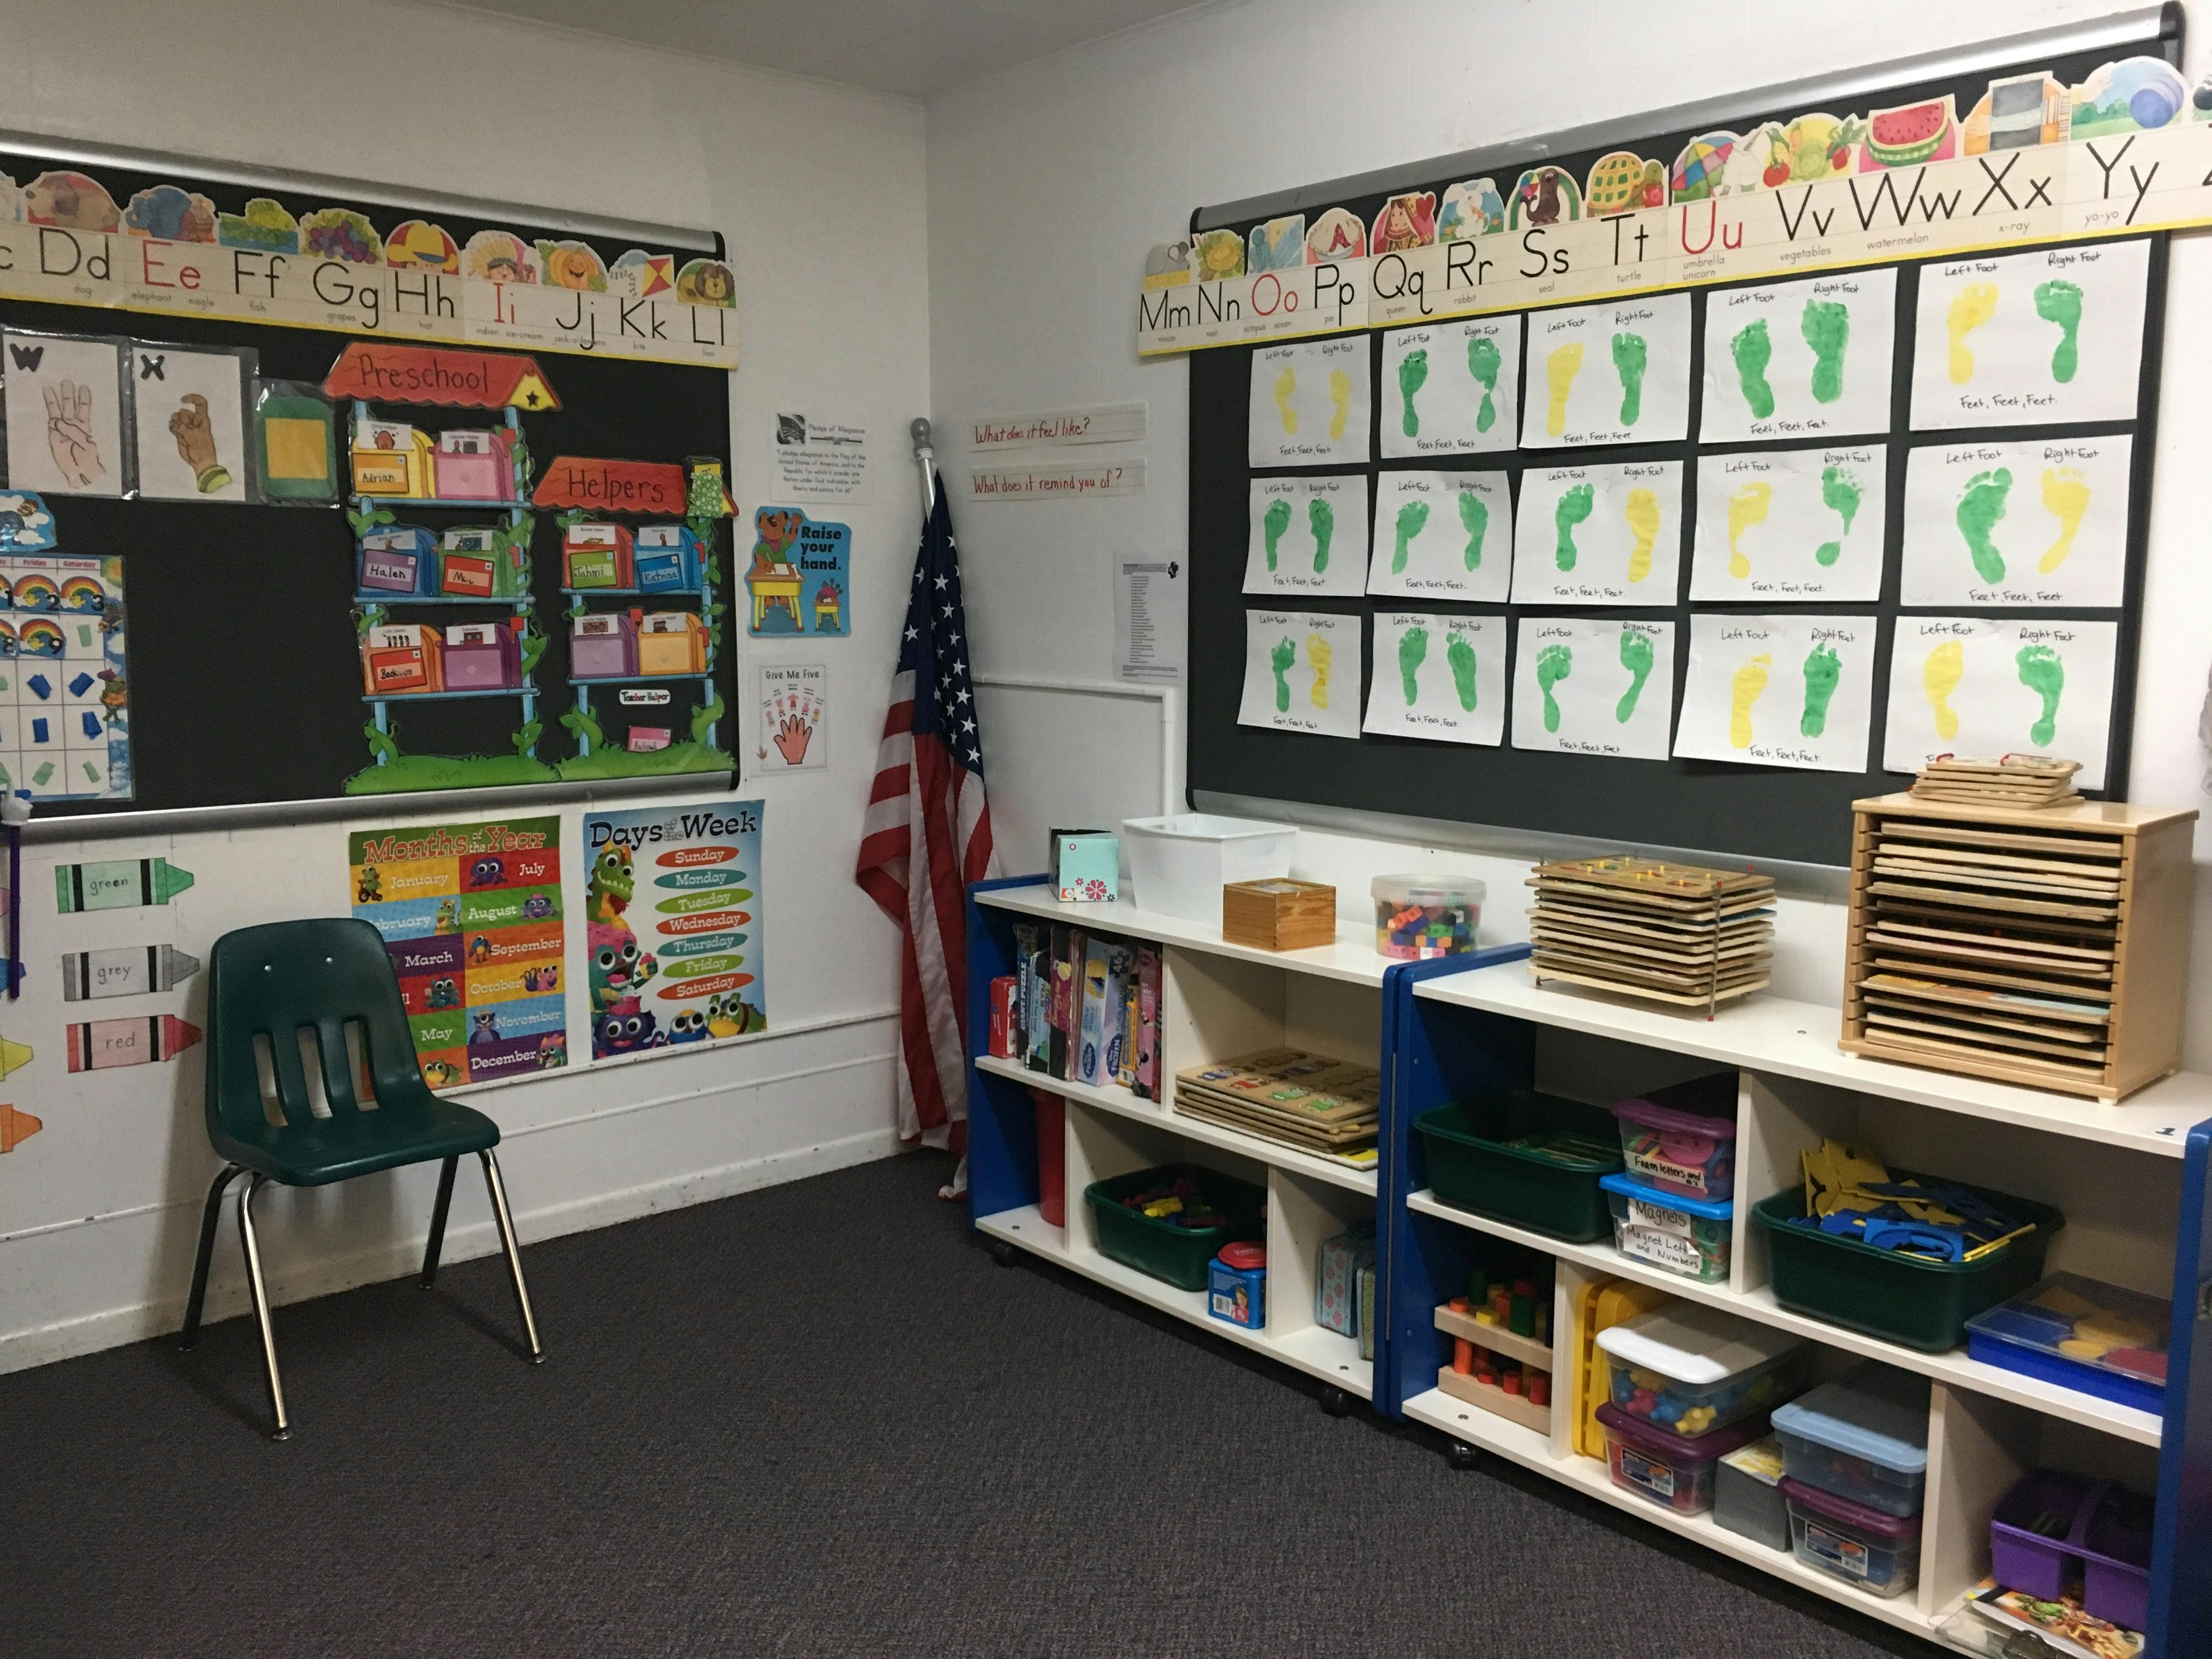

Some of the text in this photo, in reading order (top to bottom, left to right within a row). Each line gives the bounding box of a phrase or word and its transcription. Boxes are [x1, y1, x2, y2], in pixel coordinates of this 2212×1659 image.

[1139, 289, 1190, 332] Mm
[1198, 281, 1240, 325] Nn
[1251, 273, 1299, 316] Oo
[1314, 264, 1355, 327] Pp
[1373, 253, 1433, 315] Qq
[1447, 240, 1493, 290] Rr
[1520, 228, 1570, 278] Ss
[1600, 213, 1649, 266] Tt
[1682, 200, 1742, 255] Uu
[1775, 184, 1835, 241] Vv
[1848, 166, 1962, 231] Ww
[1972, 152, 2052, 216] Xx
[2085, 135, 2160, 226] Yy
[2047, 251, 2103, 268] Right Foot
[1158, 210, 2119, 343] mouse nest octopus ocean pie queen rabbit seal turtle umbrella vegetables watermelon x-ray yo-yo
[1682, 269, 1716, 281] unicorn
[1945, 262, 1999, 276] Left Foot
[39, 227, 110, 281] Dd
[142, 240, 201, 290] Ee
[234, 250, 286, 298] Ff
[313, 262, 379, 329] Gg
[394, 270, 454, 318] Hh
[493, 282, 515, 325] Ii
[556, 292, 595, 351] Jj
[620, 297, 667, 341] Kk
[691, 306, 724, 346] Ll
[74, 284, 92, 299] dog
[131, 289, 171, 304] elephant
[188, 296, 215, 311] eagle
[249, 301, 267, 313] fish
[326, 312, 356, 323] grapes
[419, 321, 432, 330] hat
[506, 331, 544, 341] ice-cream
[633, 341, 646, 351] kite
[702, 348, 715, 357] lion
[1464, 326, 1500, 336] Right Foot
[1398, 334, 1431, 347] Left Foot
[9, 342, 44, 373] W
[359, 353, 489, 394] Preschool
[809, 424, 827, 433] Pledge
[838, 426, 865, 435] Allegiance
[974, 416, 1091, 444] What does it feel like?
[1946, 448, 2004, 465] Left Foot
[2044, 447, 2100, 463] Right Foot
[362, 471, 396, 484] Adrian
[973, 475, 998, 494] What
[1001, 476, 1022, 492] does
[1025, 473, 1034, 492] it
[1039, 475, 1075, 490] remind
[1078, 478, 1096, 492] you
[568, 467, 664, 506] Helpers
[801, 526, 842, 540] Raise
[800, 542, 834, 555] your
[800, 556, 841, 571] hand.
[644, 570, 678, 583] Katrina
[4, 590, 14, 607] 1
[44, 594, 60, 612] 2
[91, 594, 105, 612] 3
[1920, 623, 1976, 636] Left Foot
[2019, 627, 2076, 642] Right Foot
[48, 637, 64, 654] 9
[766, 669, 820, 680] Give Me Five
[620, 691, 646, 702] Teacher
[589, 810, 757, 852] Days of the Week
[364, 825, 546, 865] Months of the Year
[675, 849, 725, 865] Sunday
[520, 862, 545, 877] July
[89, 877, 129, 896] green
[390, 873, 449, 889] January
[675, 872, 727, 887] Monday
[678, 892, 731, 911] Tuesday
[468, 905, 517, 922] August
[669, 912, 742, 932] Wednesday
[369, 916, 431, 931] ebruary
[490, 938, 562, 957] September
[673, 935, 735, 953] Thursday
[404, 951, 454, 967] March
[685, 956, 728, 974] Friday
[1112, 956, 1123, 973] 46
[97, 966, 131, 985] grey
[470, 979, 522, 995] October
[676, 975, 735, 997] Saturday
[495, 1010, 561, 1029] November
[105, 1032, 136, 1049] red
[421, 1028, 453, 1042] May
[471, 1048, 537, 1070] December
[1111, 1039, 1121, 1071] FROZEN
[1635, 1155, 1701, 1182] Foam letters and
[1635, 1201, 1686, 1227] Magnets
[1627, 1225, 1662, 1246] Magnet
[1636, 1243, 1699, 1269] and Numbers
